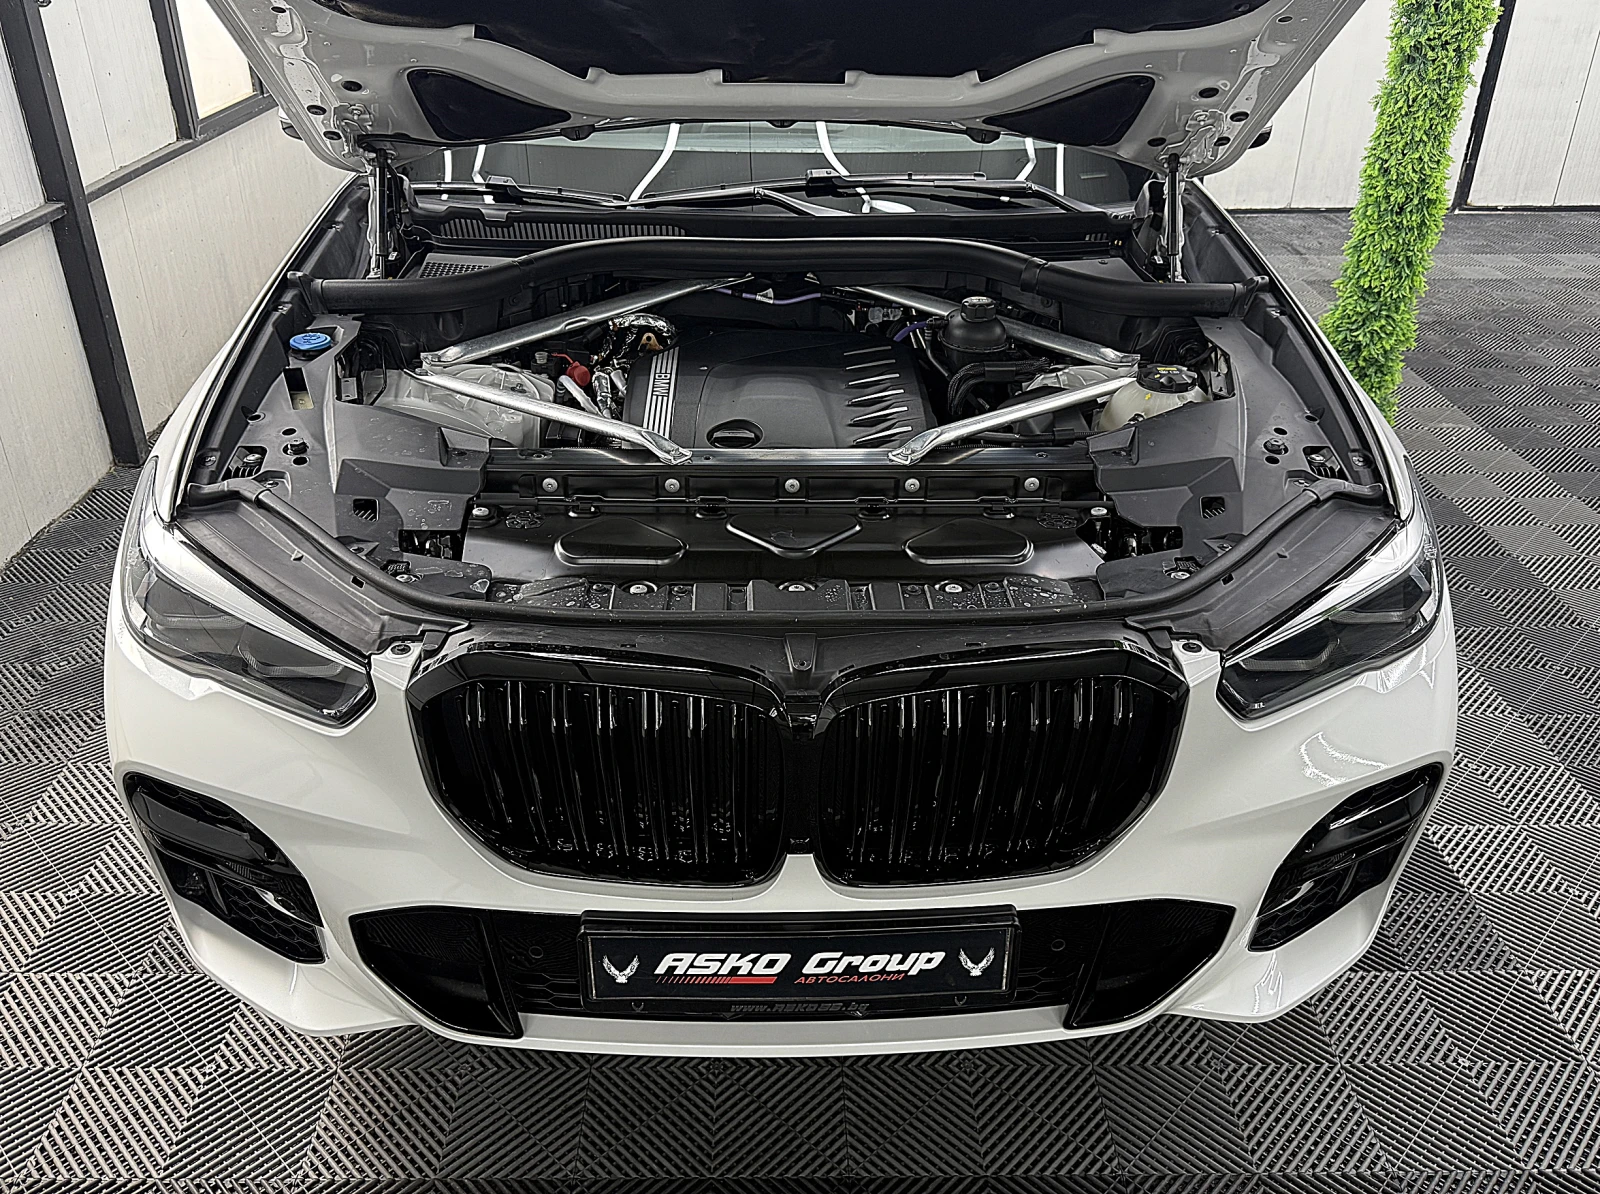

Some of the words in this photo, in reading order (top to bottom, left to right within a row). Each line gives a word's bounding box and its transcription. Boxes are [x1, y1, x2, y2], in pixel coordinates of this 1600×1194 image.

[653, 373, 671, 396] BMW
[653, 952, 793, 975] ASKO
[801, 951, 947, 976] Group
[793, 972, 906, 985] АВТОСАЛОНИ
